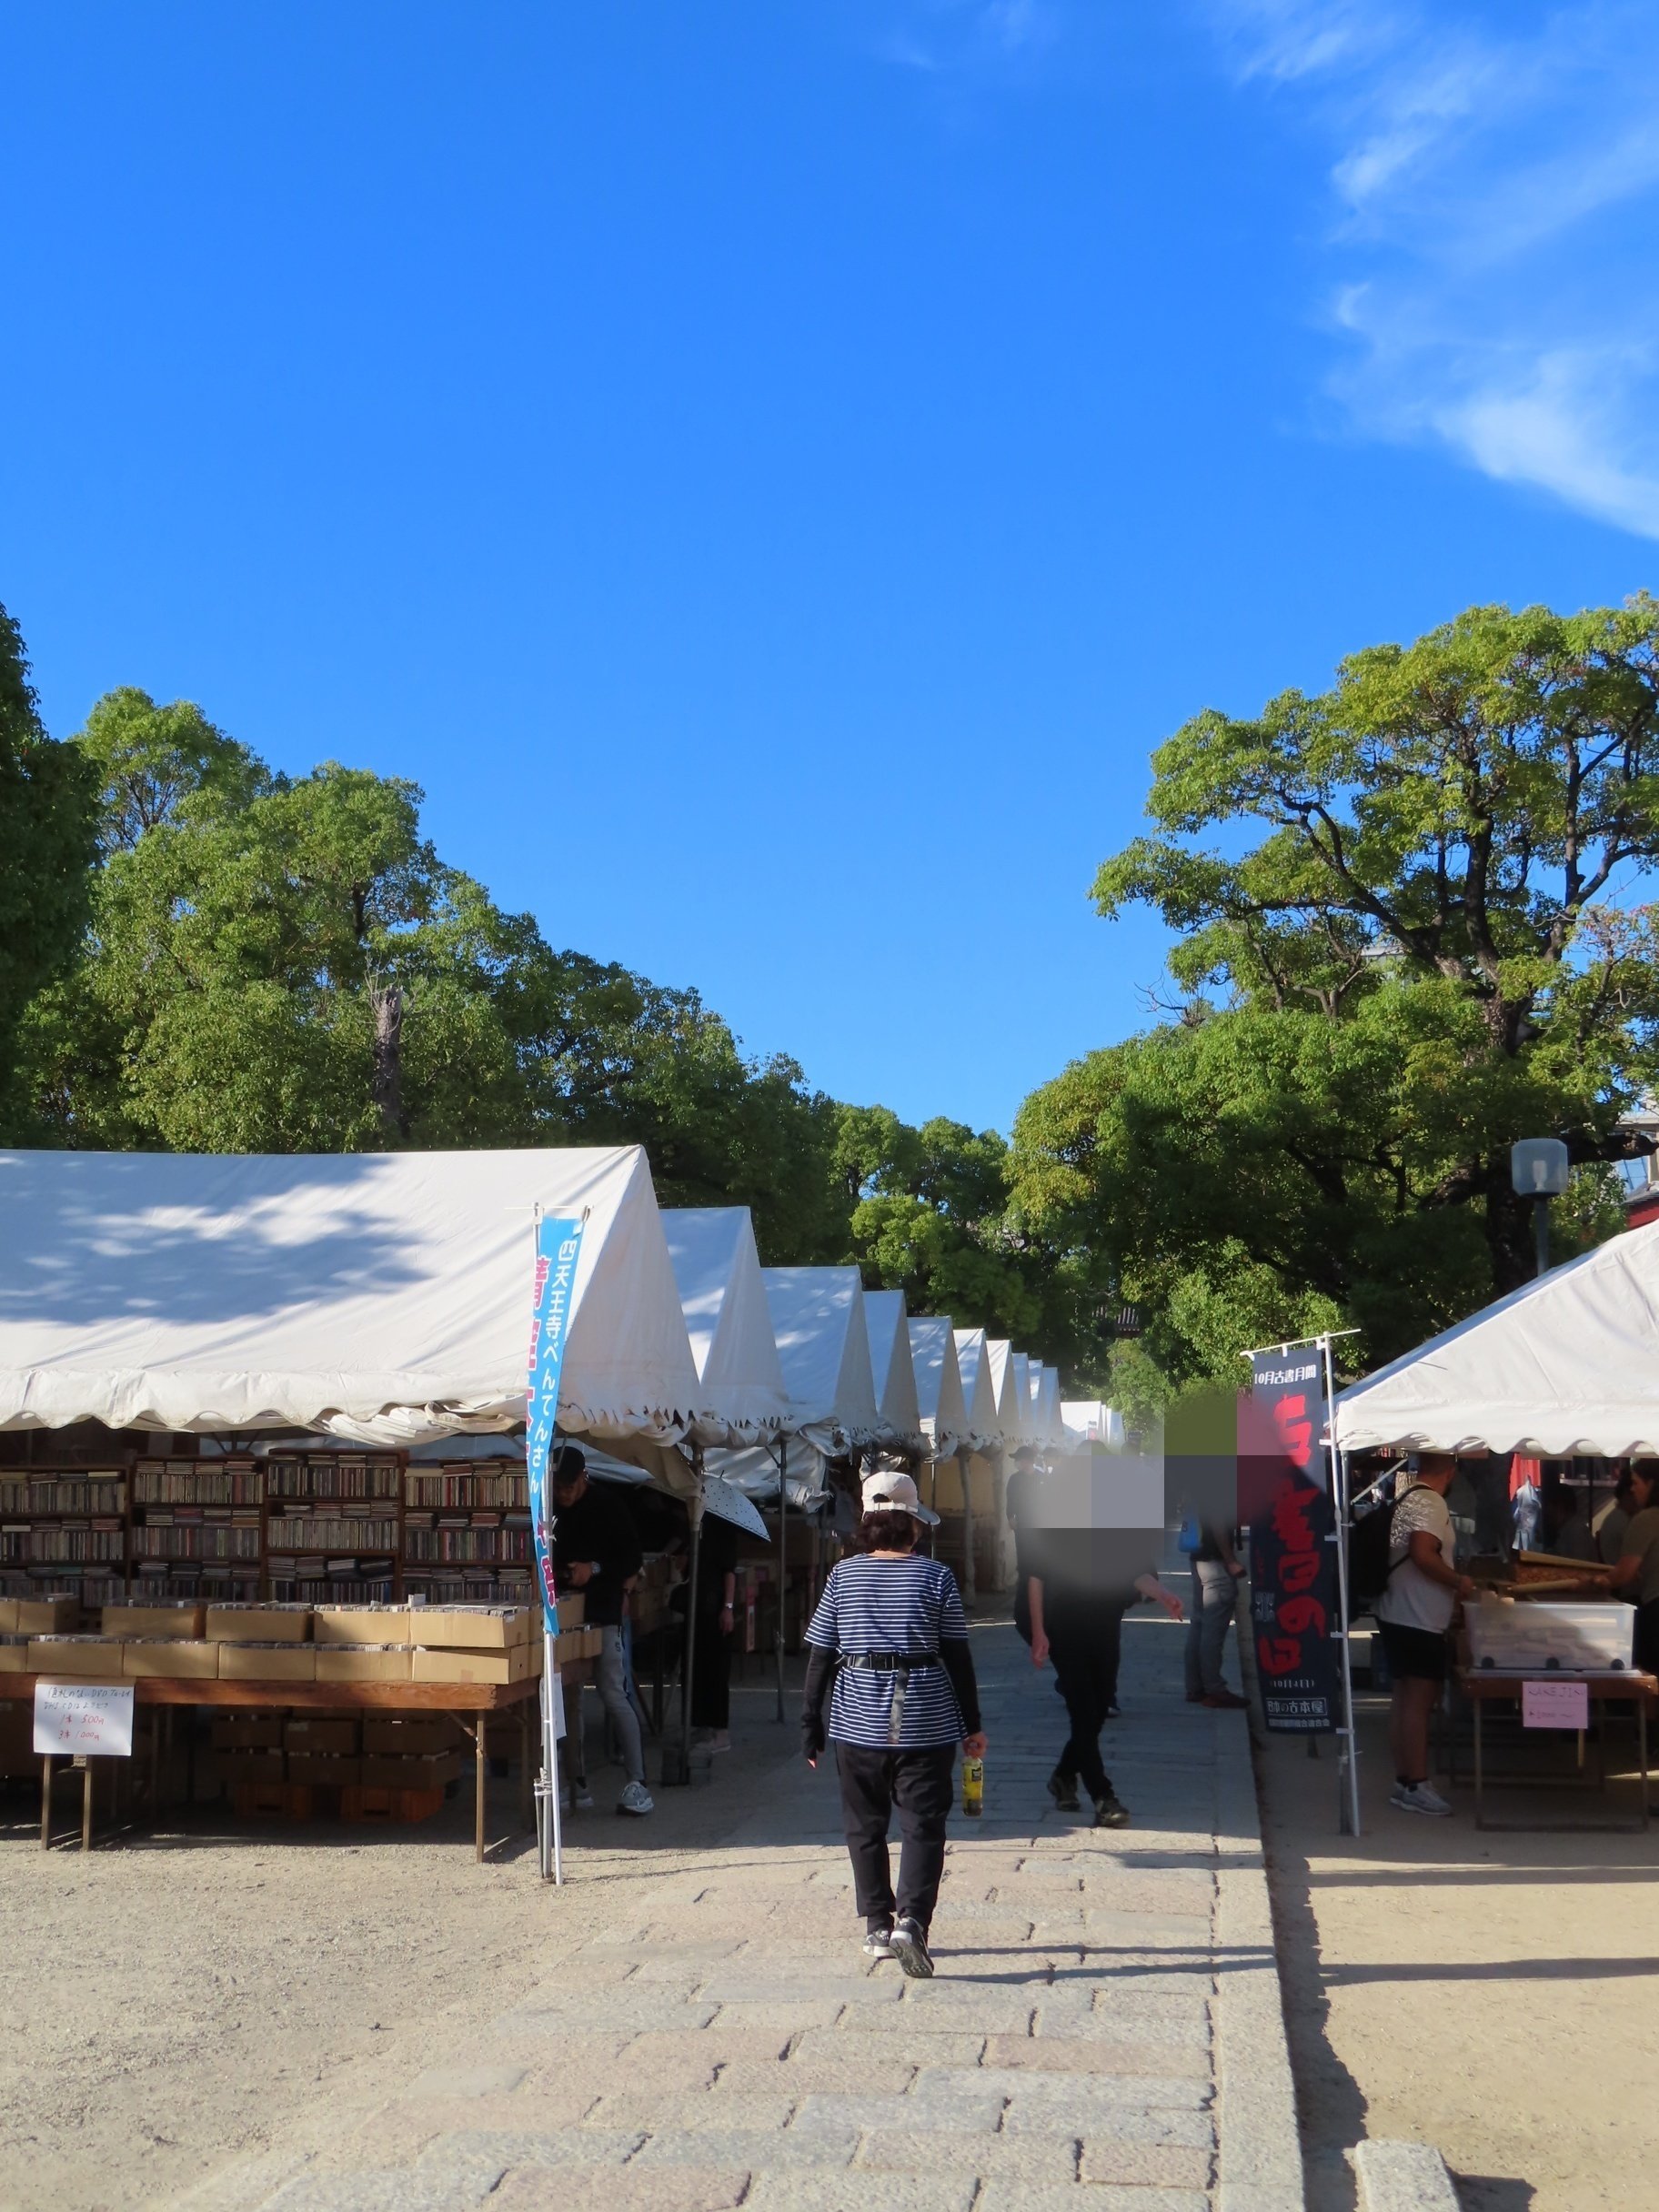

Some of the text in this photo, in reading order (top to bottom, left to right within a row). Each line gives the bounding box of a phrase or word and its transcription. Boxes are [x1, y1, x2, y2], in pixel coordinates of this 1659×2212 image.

[529, 1239, 577, 1494] 四天王寺べんてんさん
[1253, 1364, 1317, 1385] 10月古書月間
